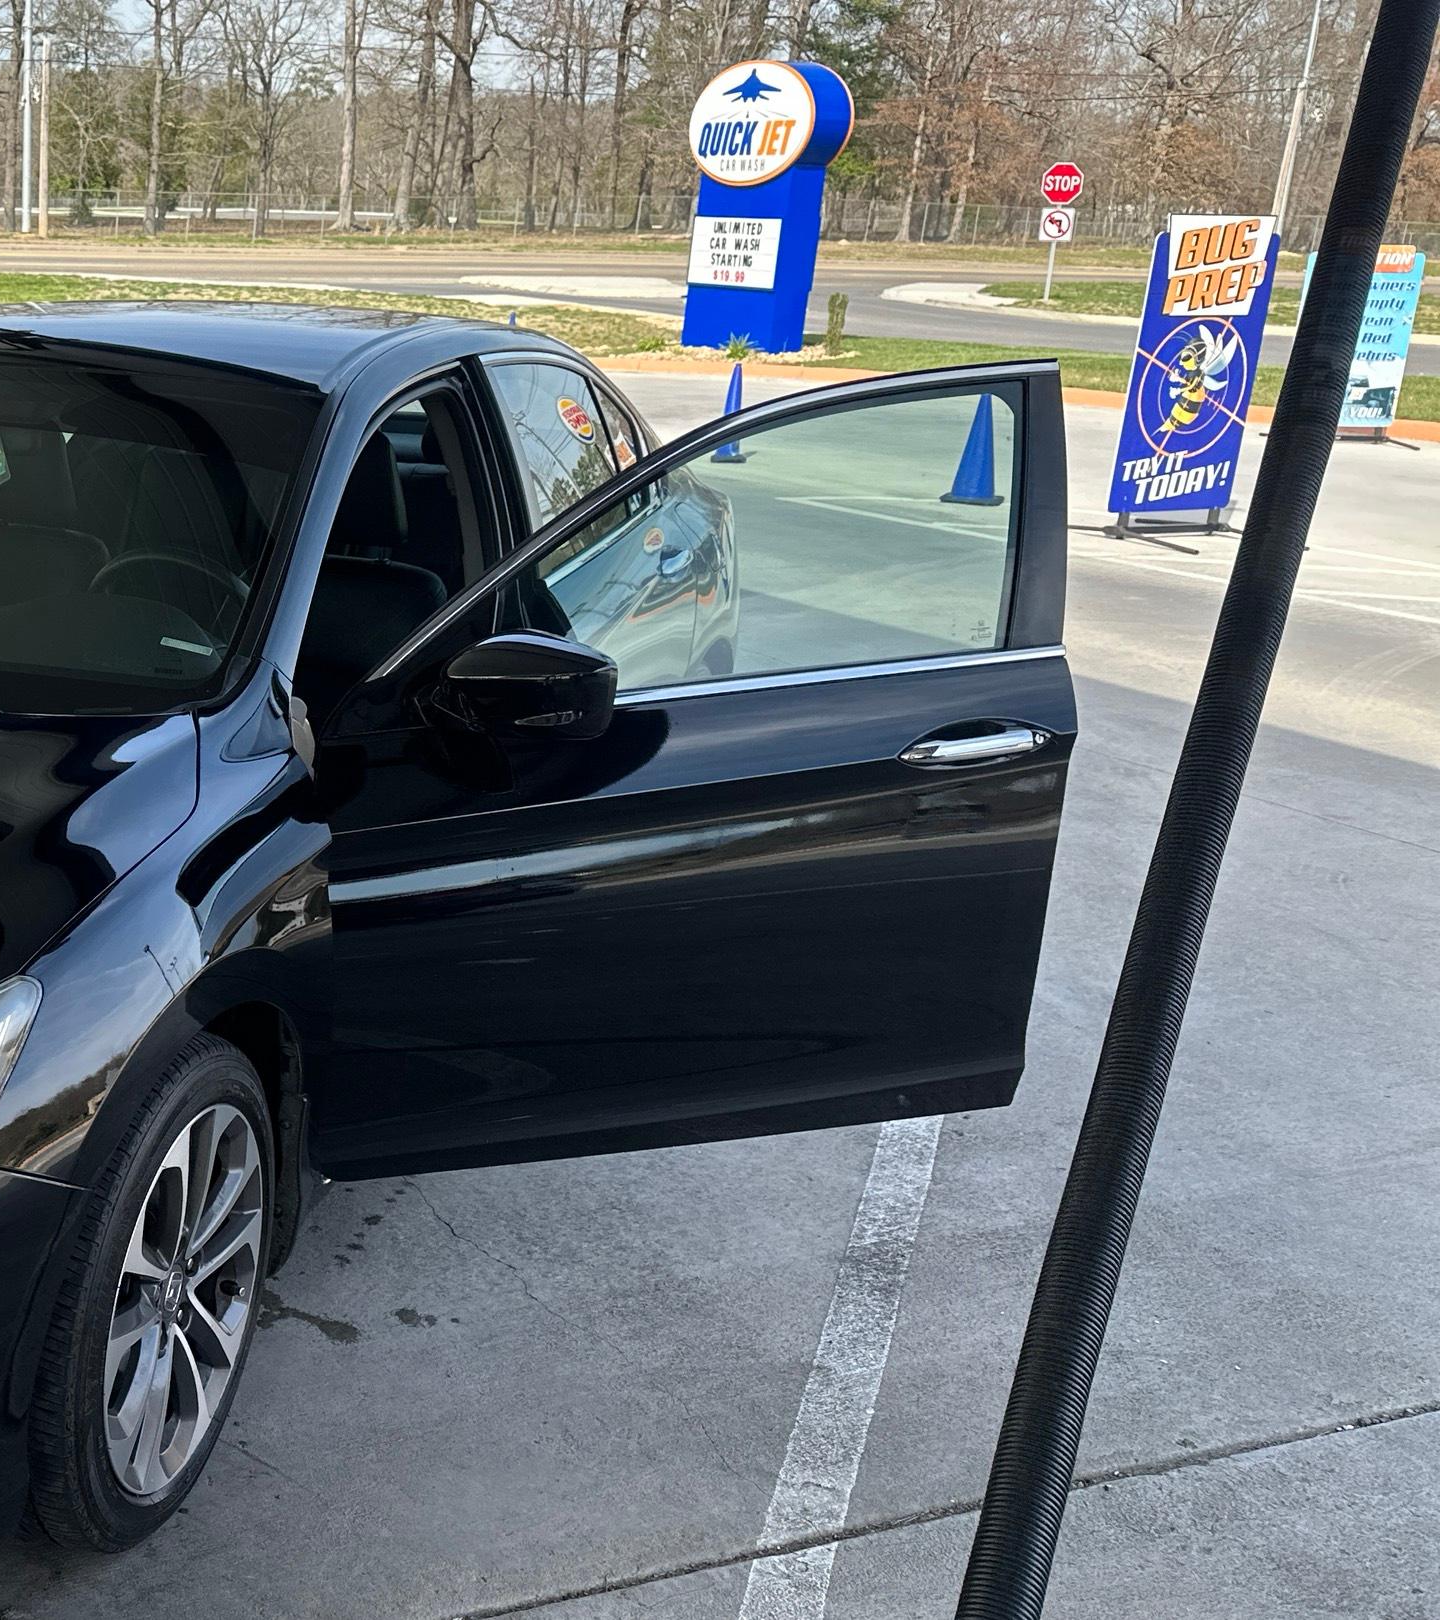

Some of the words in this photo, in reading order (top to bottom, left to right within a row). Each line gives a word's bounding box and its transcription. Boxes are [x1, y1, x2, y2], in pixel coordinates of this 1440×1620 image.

[698, 121, 758, 159] QUICK
[757, 120, 796, 156] JET
[720, 159, 736, 171] CAR
[740, 159, 765, 171] WASH
[1044, 175, 1081, 192] STOP
[713, 221, 763, 235] UNLIMITED
[710, 237, 727, 250] CAR
[734, 238, 761, 251] WASH
[1175, 219, 1261, 271] BUG
[711, 253, 753, 267] STARTING
[1375, 252, 1413, 265] TION
[713, 270, 745, 282] $19.99
[1162, 260, 1267, 315] PREP
[1367, 297, 1405, 310] mpty
[1361, 333, 1392, 343] Bed
[1356, 350, 1399, 361] ebris
[1122, 455, 1165, 482] TRY
[1164, 450, 1188, 473] IT
[1134, 460, 1231, 505] TODAY!
